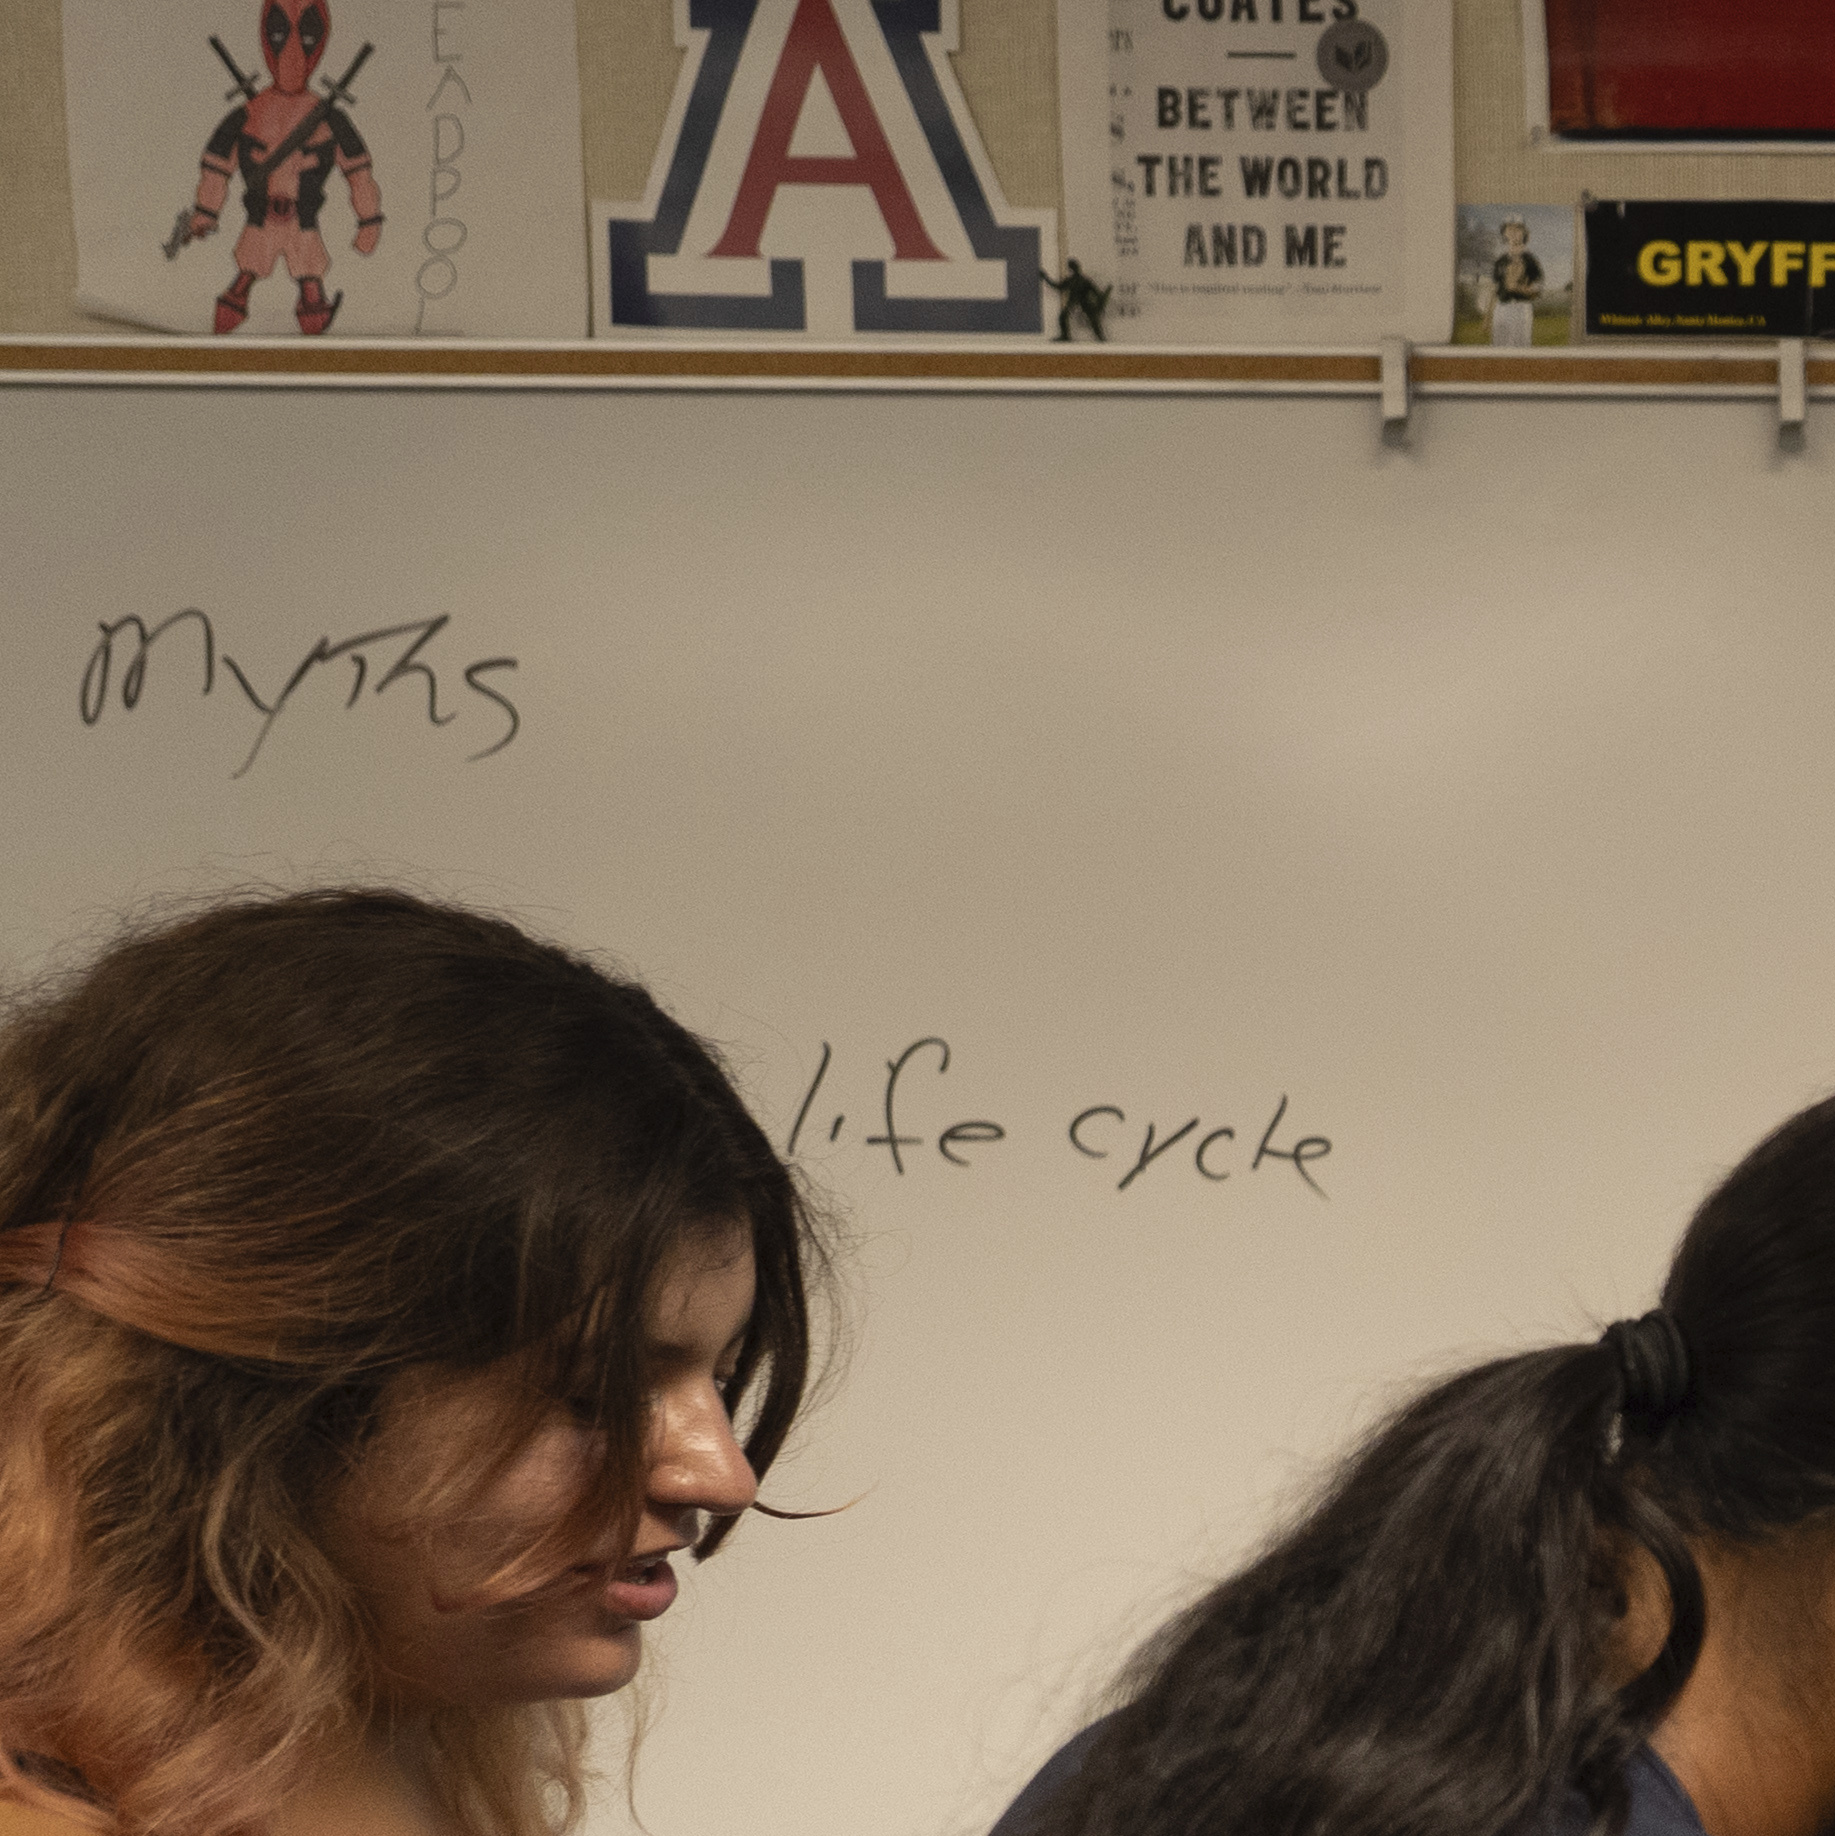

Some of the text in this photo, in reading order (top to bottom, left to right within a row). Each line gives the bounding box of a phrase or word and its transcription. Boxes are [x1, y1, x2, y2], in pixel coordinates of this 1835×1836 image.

[1156, 86, 1370, 132] BETWEEN
[1136, 154, 1390, 199] THE WORLD
[1184, 222, 1347, 268] AND ME
[787, 1036, 1332, 1200] life cycle
